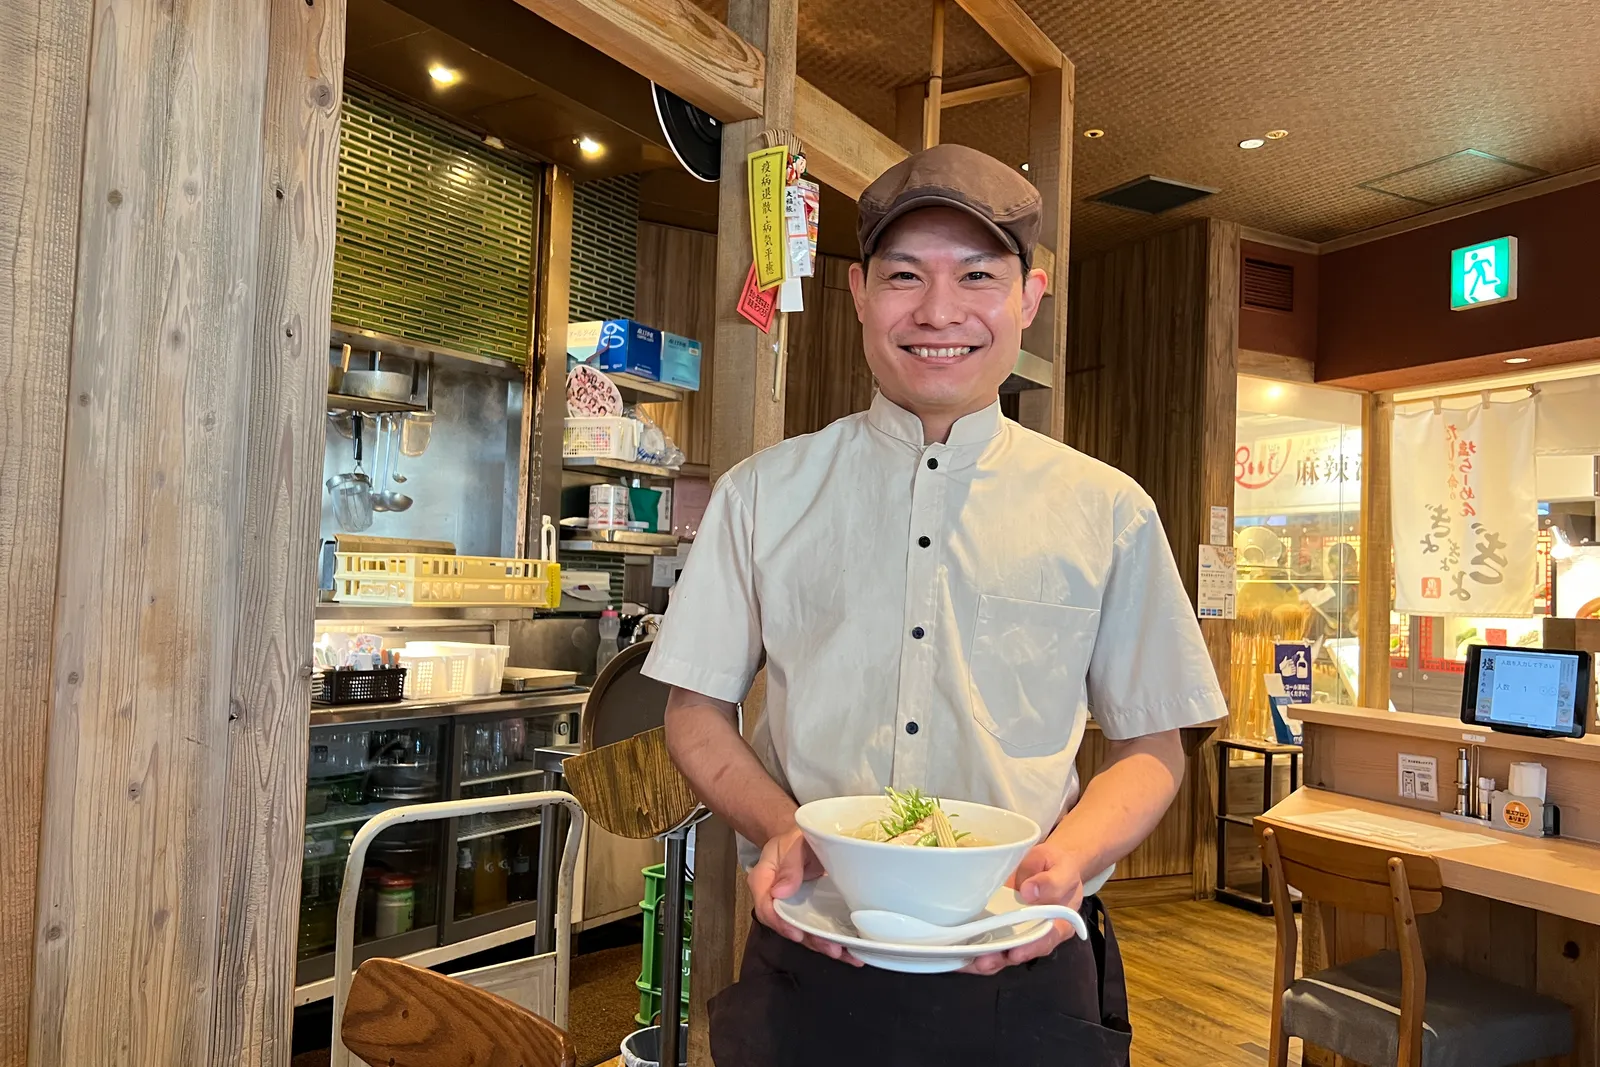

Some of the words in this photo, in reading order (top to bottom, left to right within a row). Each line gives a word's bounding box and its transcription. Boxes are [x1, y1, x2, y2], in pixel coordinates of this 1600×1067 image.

[1501, 659, 1555, 669] 人数を入力して下さい
[1496, 682, 1510, 691] 人数
